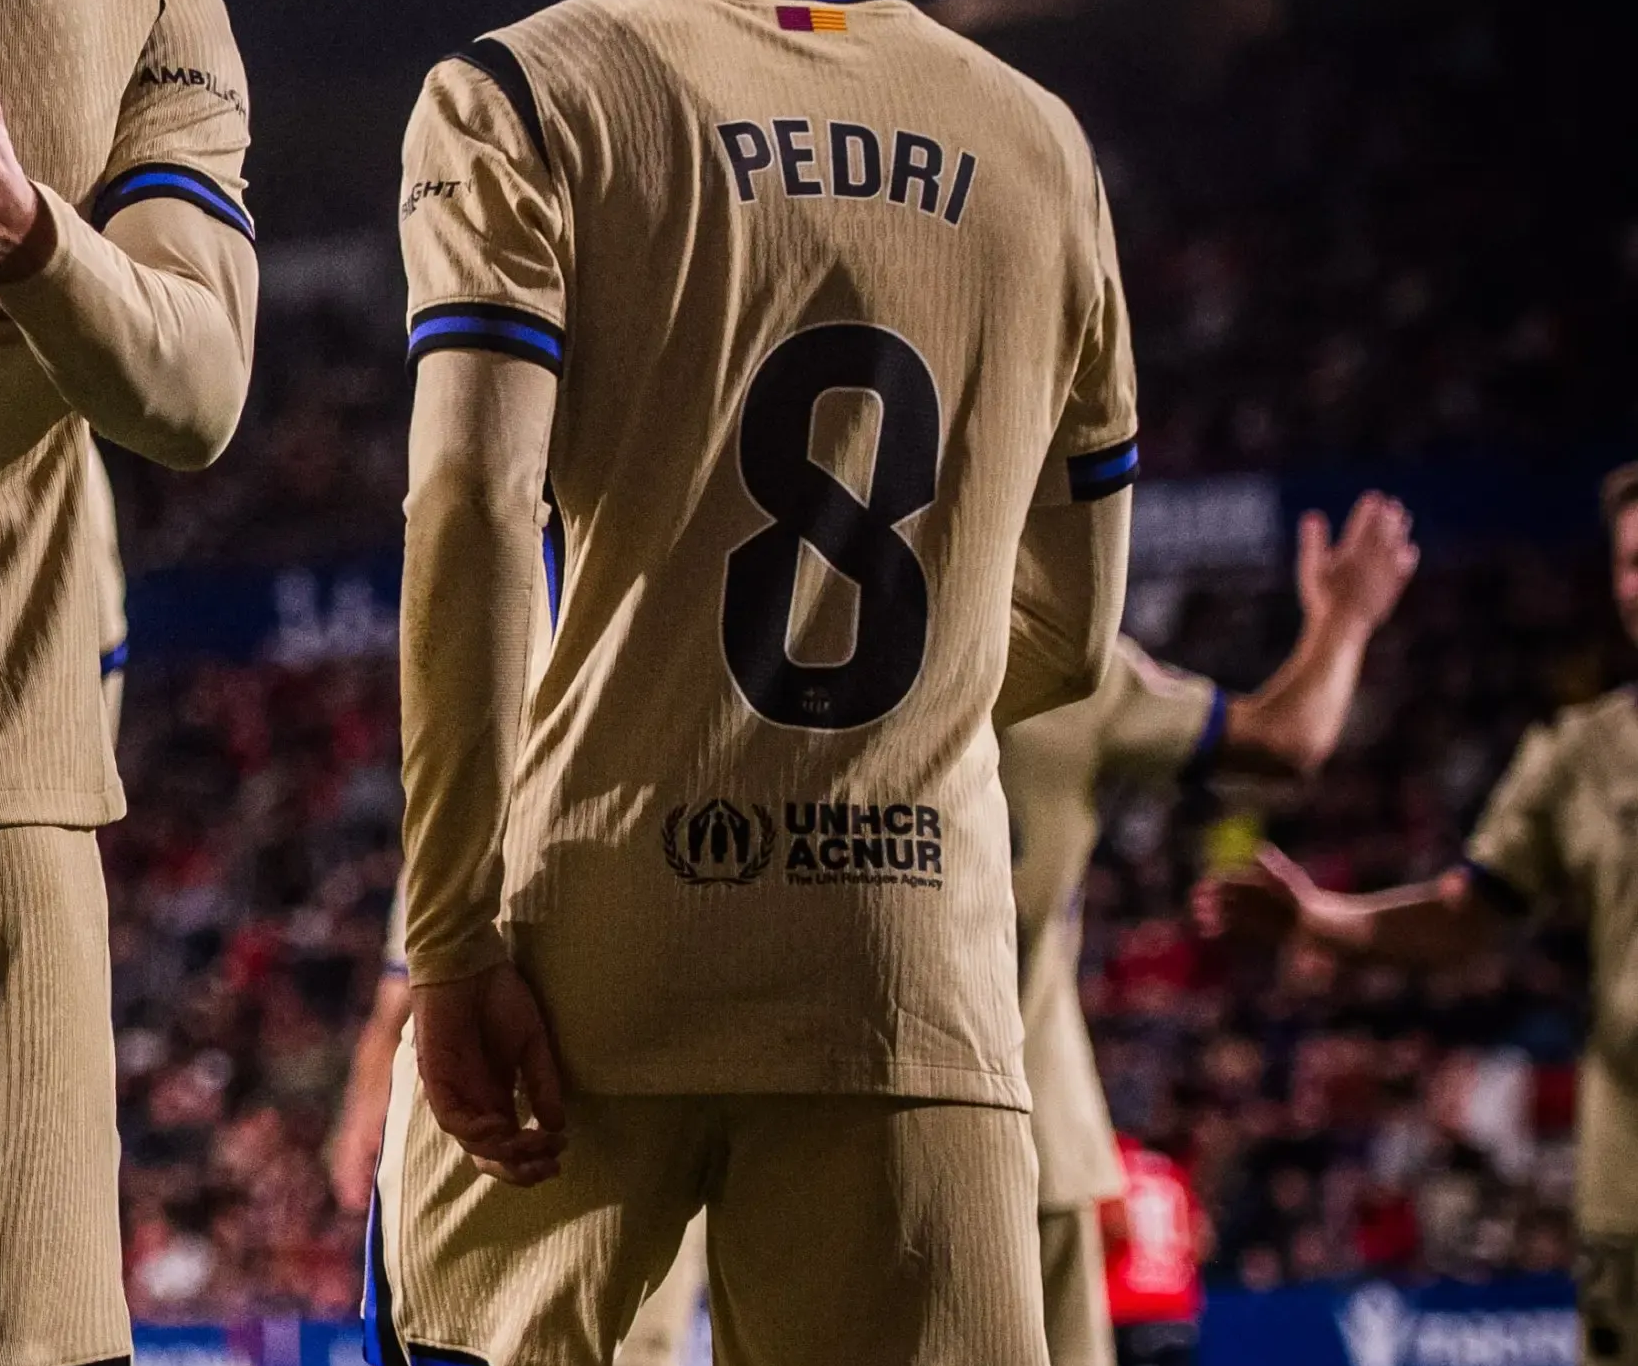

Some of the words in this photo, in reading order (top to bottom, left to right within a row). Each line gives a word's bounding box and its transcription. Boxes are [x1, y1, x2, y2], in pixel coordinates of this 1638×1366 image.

[715, 116, 978, 228] PEDRI
[718, 321, 943, 733] 8
[785, 802, 942, 839] UNHCR
[785, 838, 942, 873] ACNUR
[901, 874, 943, 891] Agency
